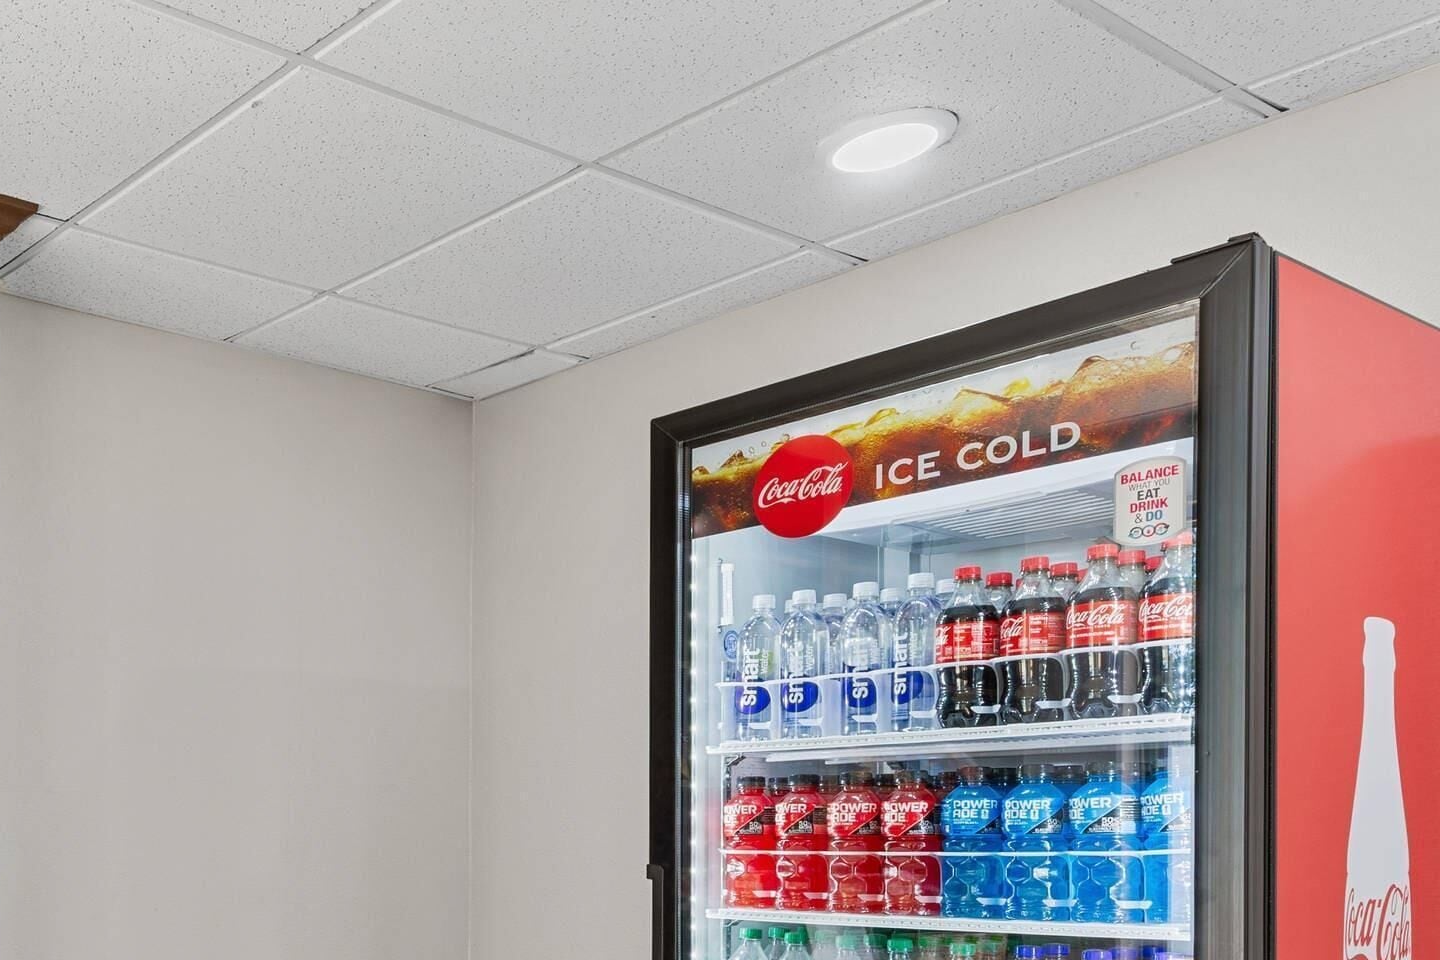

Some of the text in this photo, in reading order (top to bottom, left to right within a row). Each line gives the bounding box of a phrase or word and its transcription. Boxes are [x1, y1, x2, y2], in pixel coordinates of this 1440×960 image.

[875, 421, 1082, 490] ICE COLD
[1120, 464, 1180, 485] BALANCE
[757, 460, 849, 509] Coca-Cola
[1128, 477, 1171, 492] WHAT YOU
[1137, 487, 1161, 501] EAT
[1130, 497, 1169, 513] DRINK
[1134, 510, 1163, 524] & DO
[1139, 595, 1192, 622] Coca-Col
[1066, 603, 1128, 630] Coca-Cola
[953, 799, 998, 809] POWER
[1004, 799, 1051, 810] POWER
[952, 809, 978, 819] ADE
[1005, 809, 1029, 820] ADE
